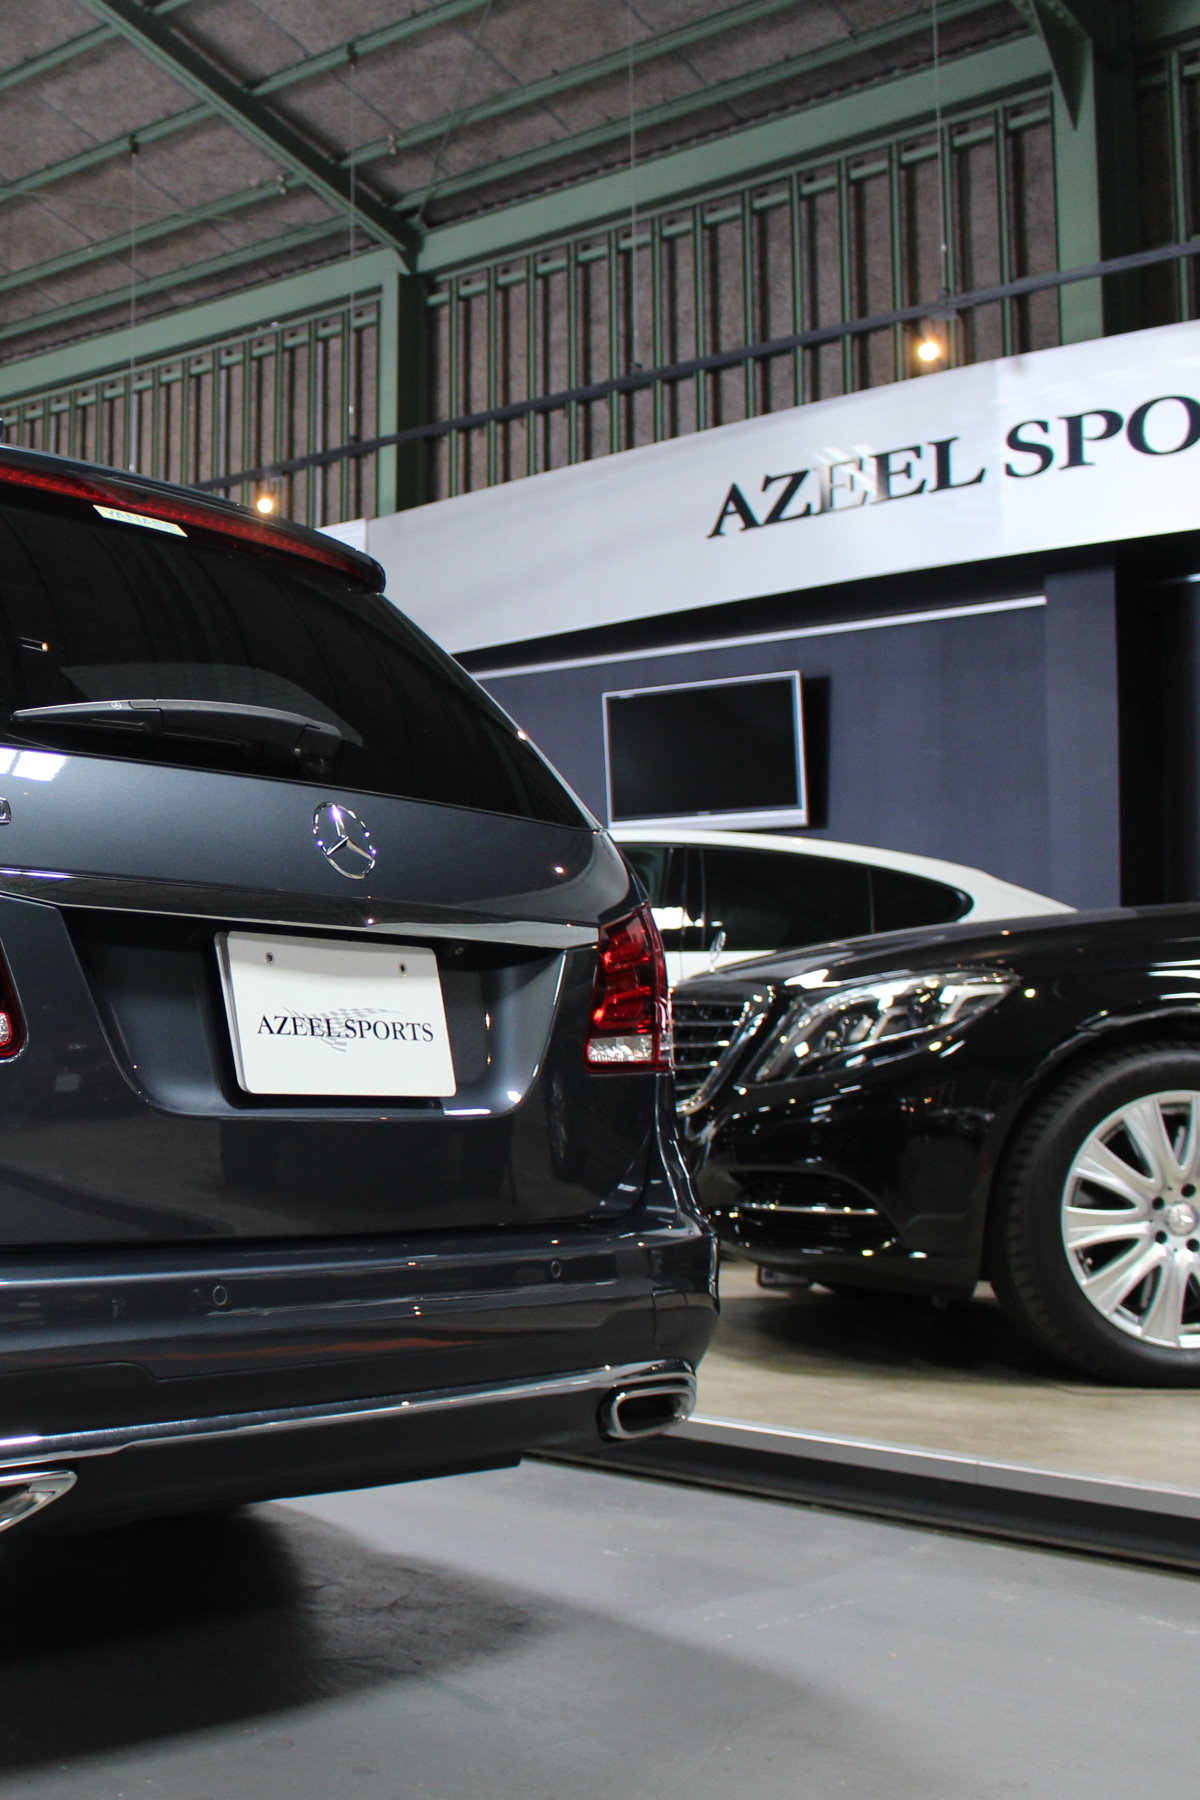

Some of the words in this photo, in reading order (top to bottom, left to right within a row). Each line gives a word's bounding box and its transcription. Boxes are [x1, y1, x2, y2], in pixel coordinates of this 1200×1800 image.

[706, 436, 985, 539] AZEEL
[1004, 394, 1200, 478] SPO
[257, 1014, 341, 1038] AZEEL
[344, 1018, 435, 1042] SPORTS
